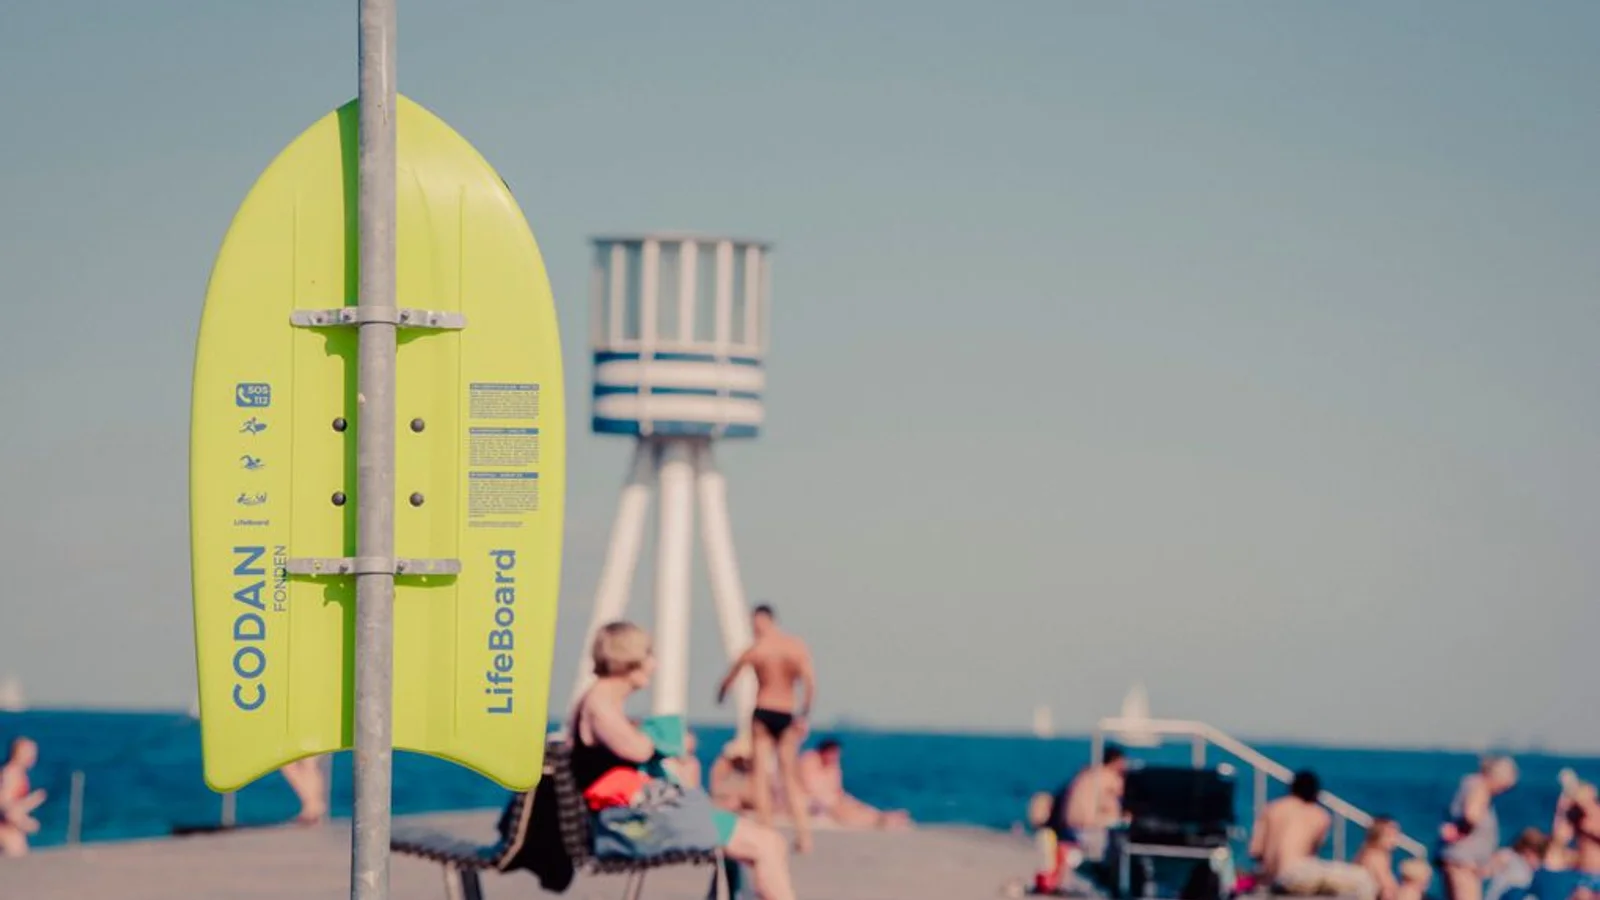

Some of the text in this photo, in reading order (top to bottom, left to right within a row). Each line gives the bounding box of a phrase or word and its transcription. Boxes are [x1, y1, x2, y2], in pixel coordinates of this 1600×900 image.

[247, 385, 268, 394] SOS
[254, 396, 268, 405] 112
[273, 545, 287, 612] FONDEN
[233, 545, 267, 711] CODAN
[485, 549, 516, 714] LifeBoard
